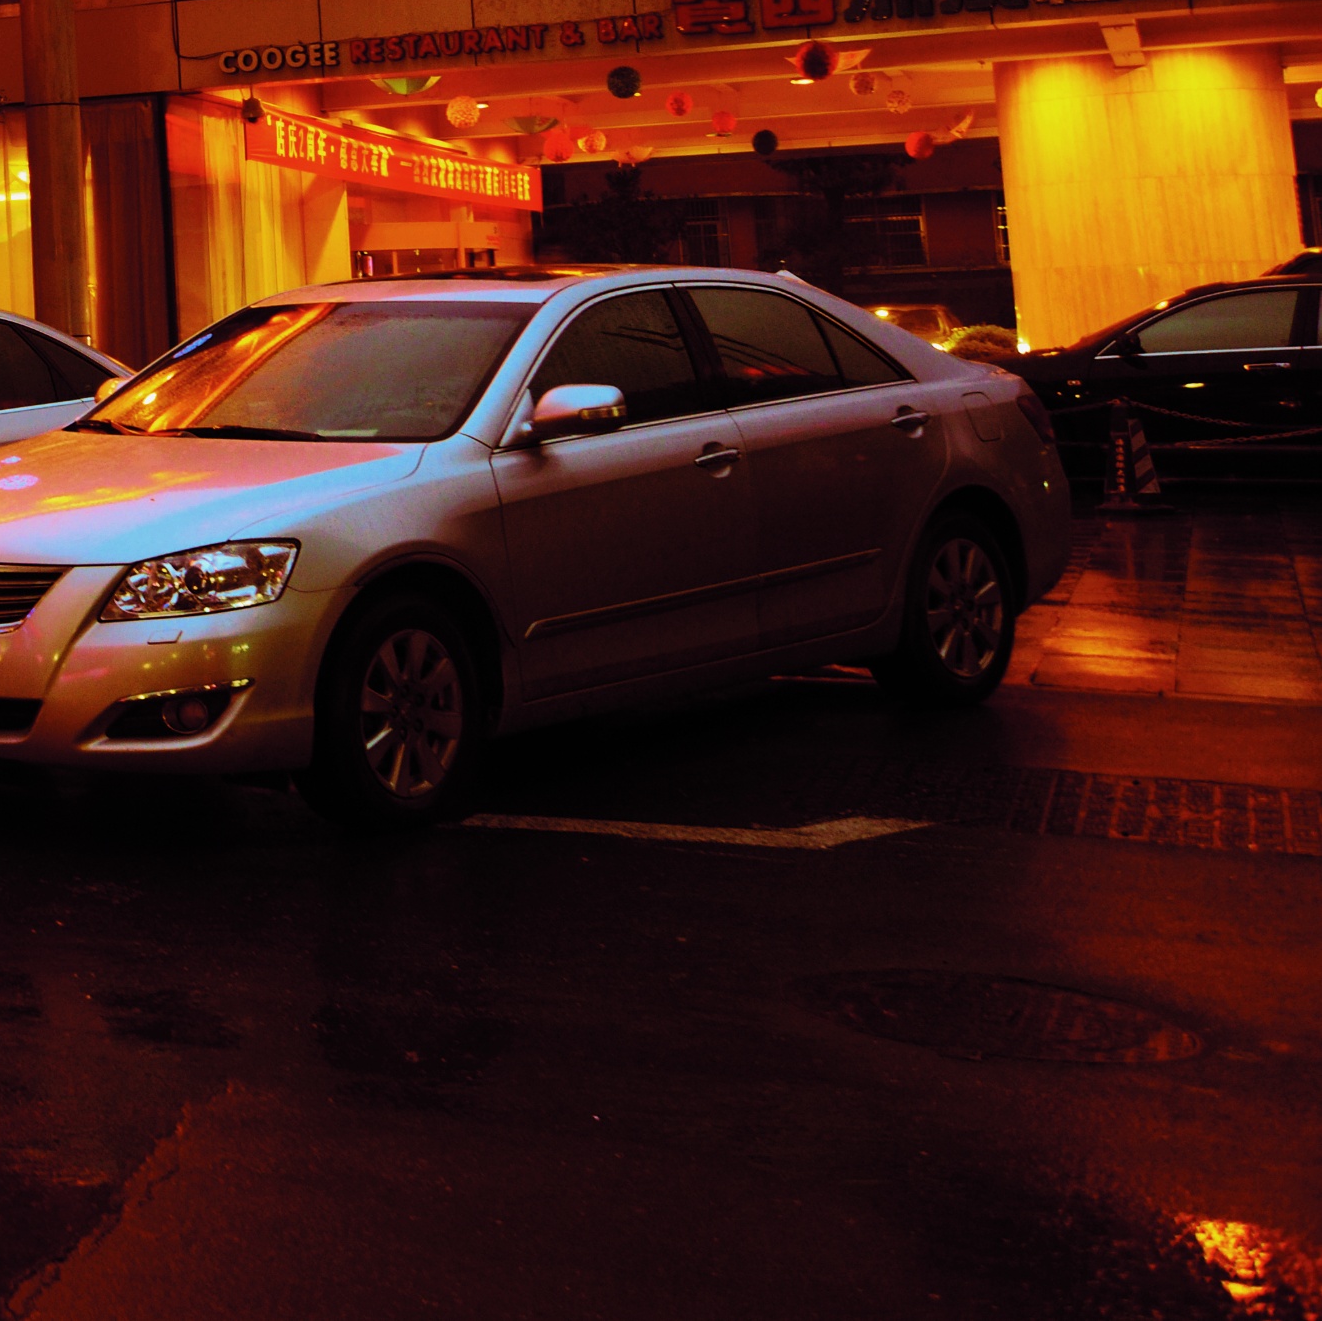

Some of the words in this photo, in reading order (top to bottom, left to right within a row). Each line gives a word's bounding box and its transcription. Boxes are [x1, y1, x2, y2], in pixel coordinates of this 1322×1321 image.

[218, 32, 339, 75] COOGEE
[350, 23, 549, 65] RESTAURANT
[560, 21, 584, 46] &
[597, 13, 664, 44] BAR
